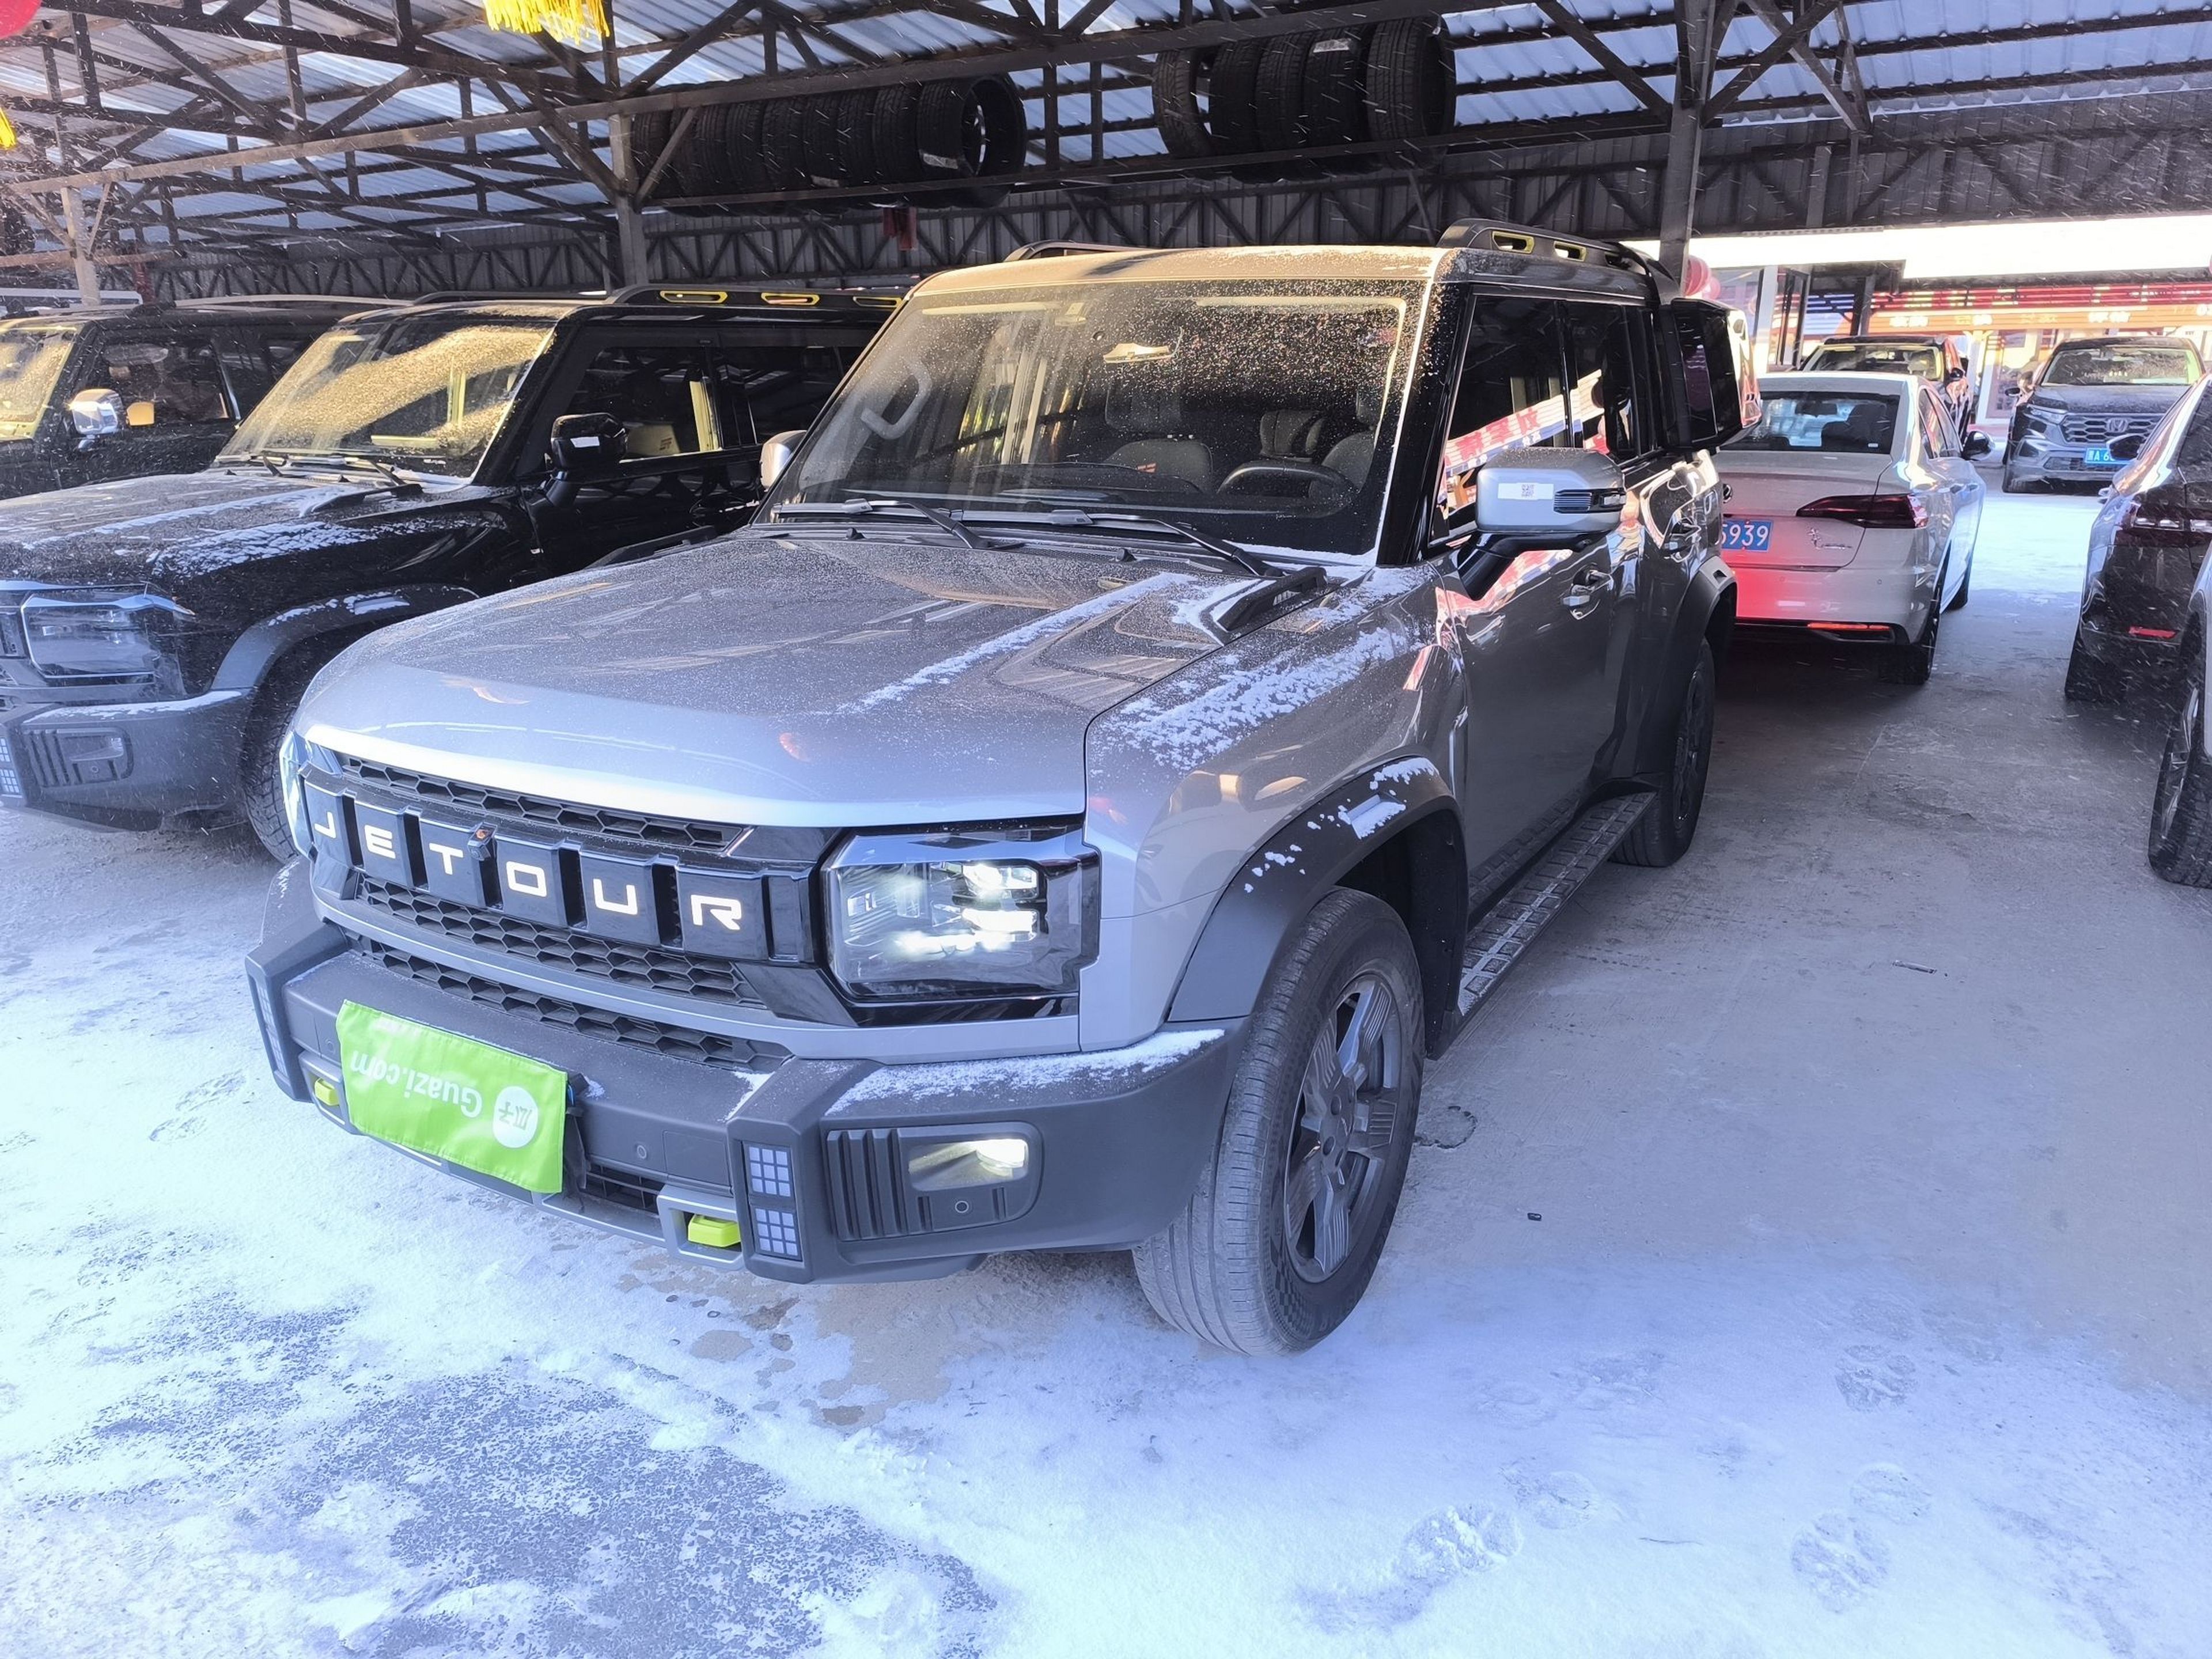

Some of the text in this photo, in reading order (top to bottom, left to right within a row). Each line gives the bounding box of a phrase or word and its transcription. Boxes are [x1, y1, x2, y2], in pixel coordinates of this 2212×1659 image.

[315, 812, 742, 931] JETOUR
[350, 1050, 532, 1131] 瓜子 Guazi.com
